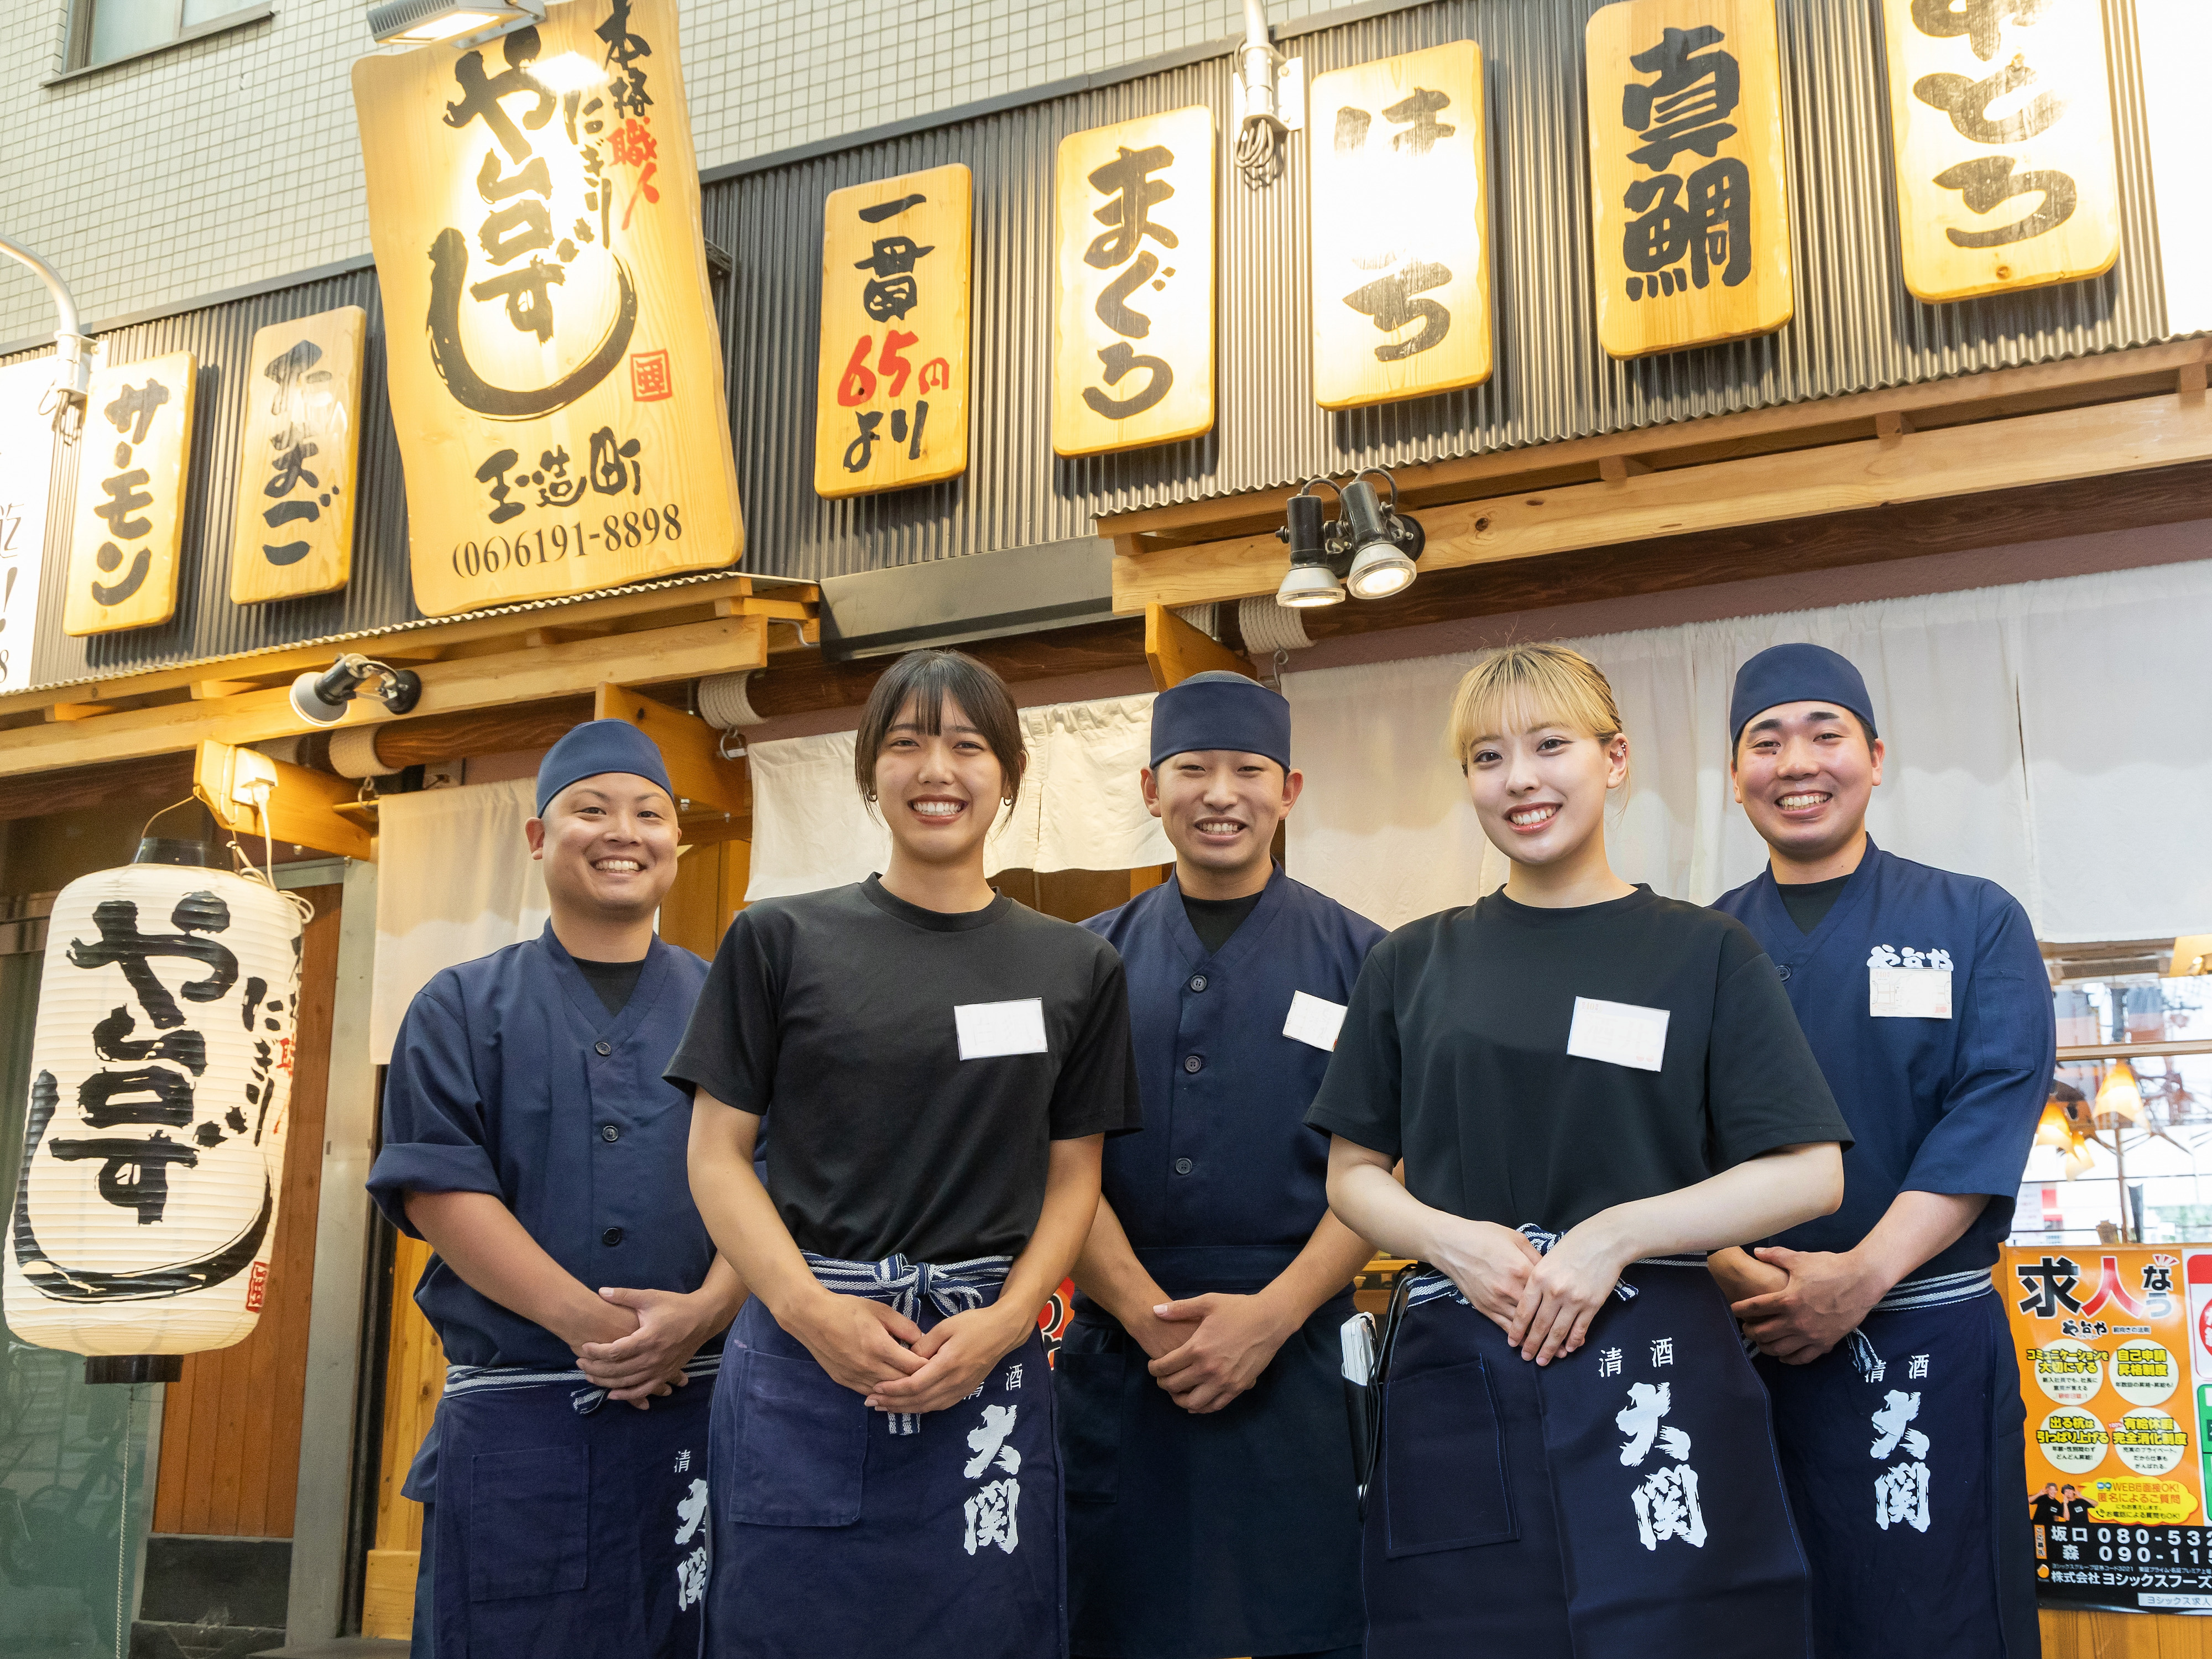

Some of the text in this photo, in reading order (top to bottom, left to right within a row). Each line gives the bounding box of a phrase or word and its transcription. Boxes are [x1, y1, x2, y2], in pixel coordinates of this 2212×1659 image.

[563, 90, 612, 249] にぎり
[1623, 25, 1752, 302] 真鯛
[853, 194, 936, 323] 一貫
[1082, 145, 1179, 420] まぐろ
[843, 400, 929, 473] より
[91, 378, 170, 606] サーモン
[475, 426, 641, 525] 玉造町
[452, 504, 682, 578] (06)6191-8898
[242, 977, 283, 1147] にぎり
[1599, 1337, 1673, 1378] 清酒
[2026, 1348, 2109, 1361] コミュニケーションを
[2039, 1361, 2098, 1374] 大切にする
[2117, 1349, 2167, 1361] 自己申請
[2118, 1363, 2168, 1376] 昇格制度
[2036, 1430, 2110, 1444] 引っぱり上げる
[2049, 1416, 2095, 1430] 出る杭は
[2112, 1432, 2188, 1446] 完全消化制度
[2123, 1417, 2174, 1431] 有給休暇
[674, 1449, 691, 1473] 清
[963, 1404, 1021, 1555] 大関
[1615, 1382, 1707, 1551] 大関
[1870, 1389, 1931, 1533] 大関
[2098, 1493, 2180, 1504] 匿名によるご質問
[2051, 1526, 2088, 1542] 坂口
[2062, 1544, 2080, 1560] 森
